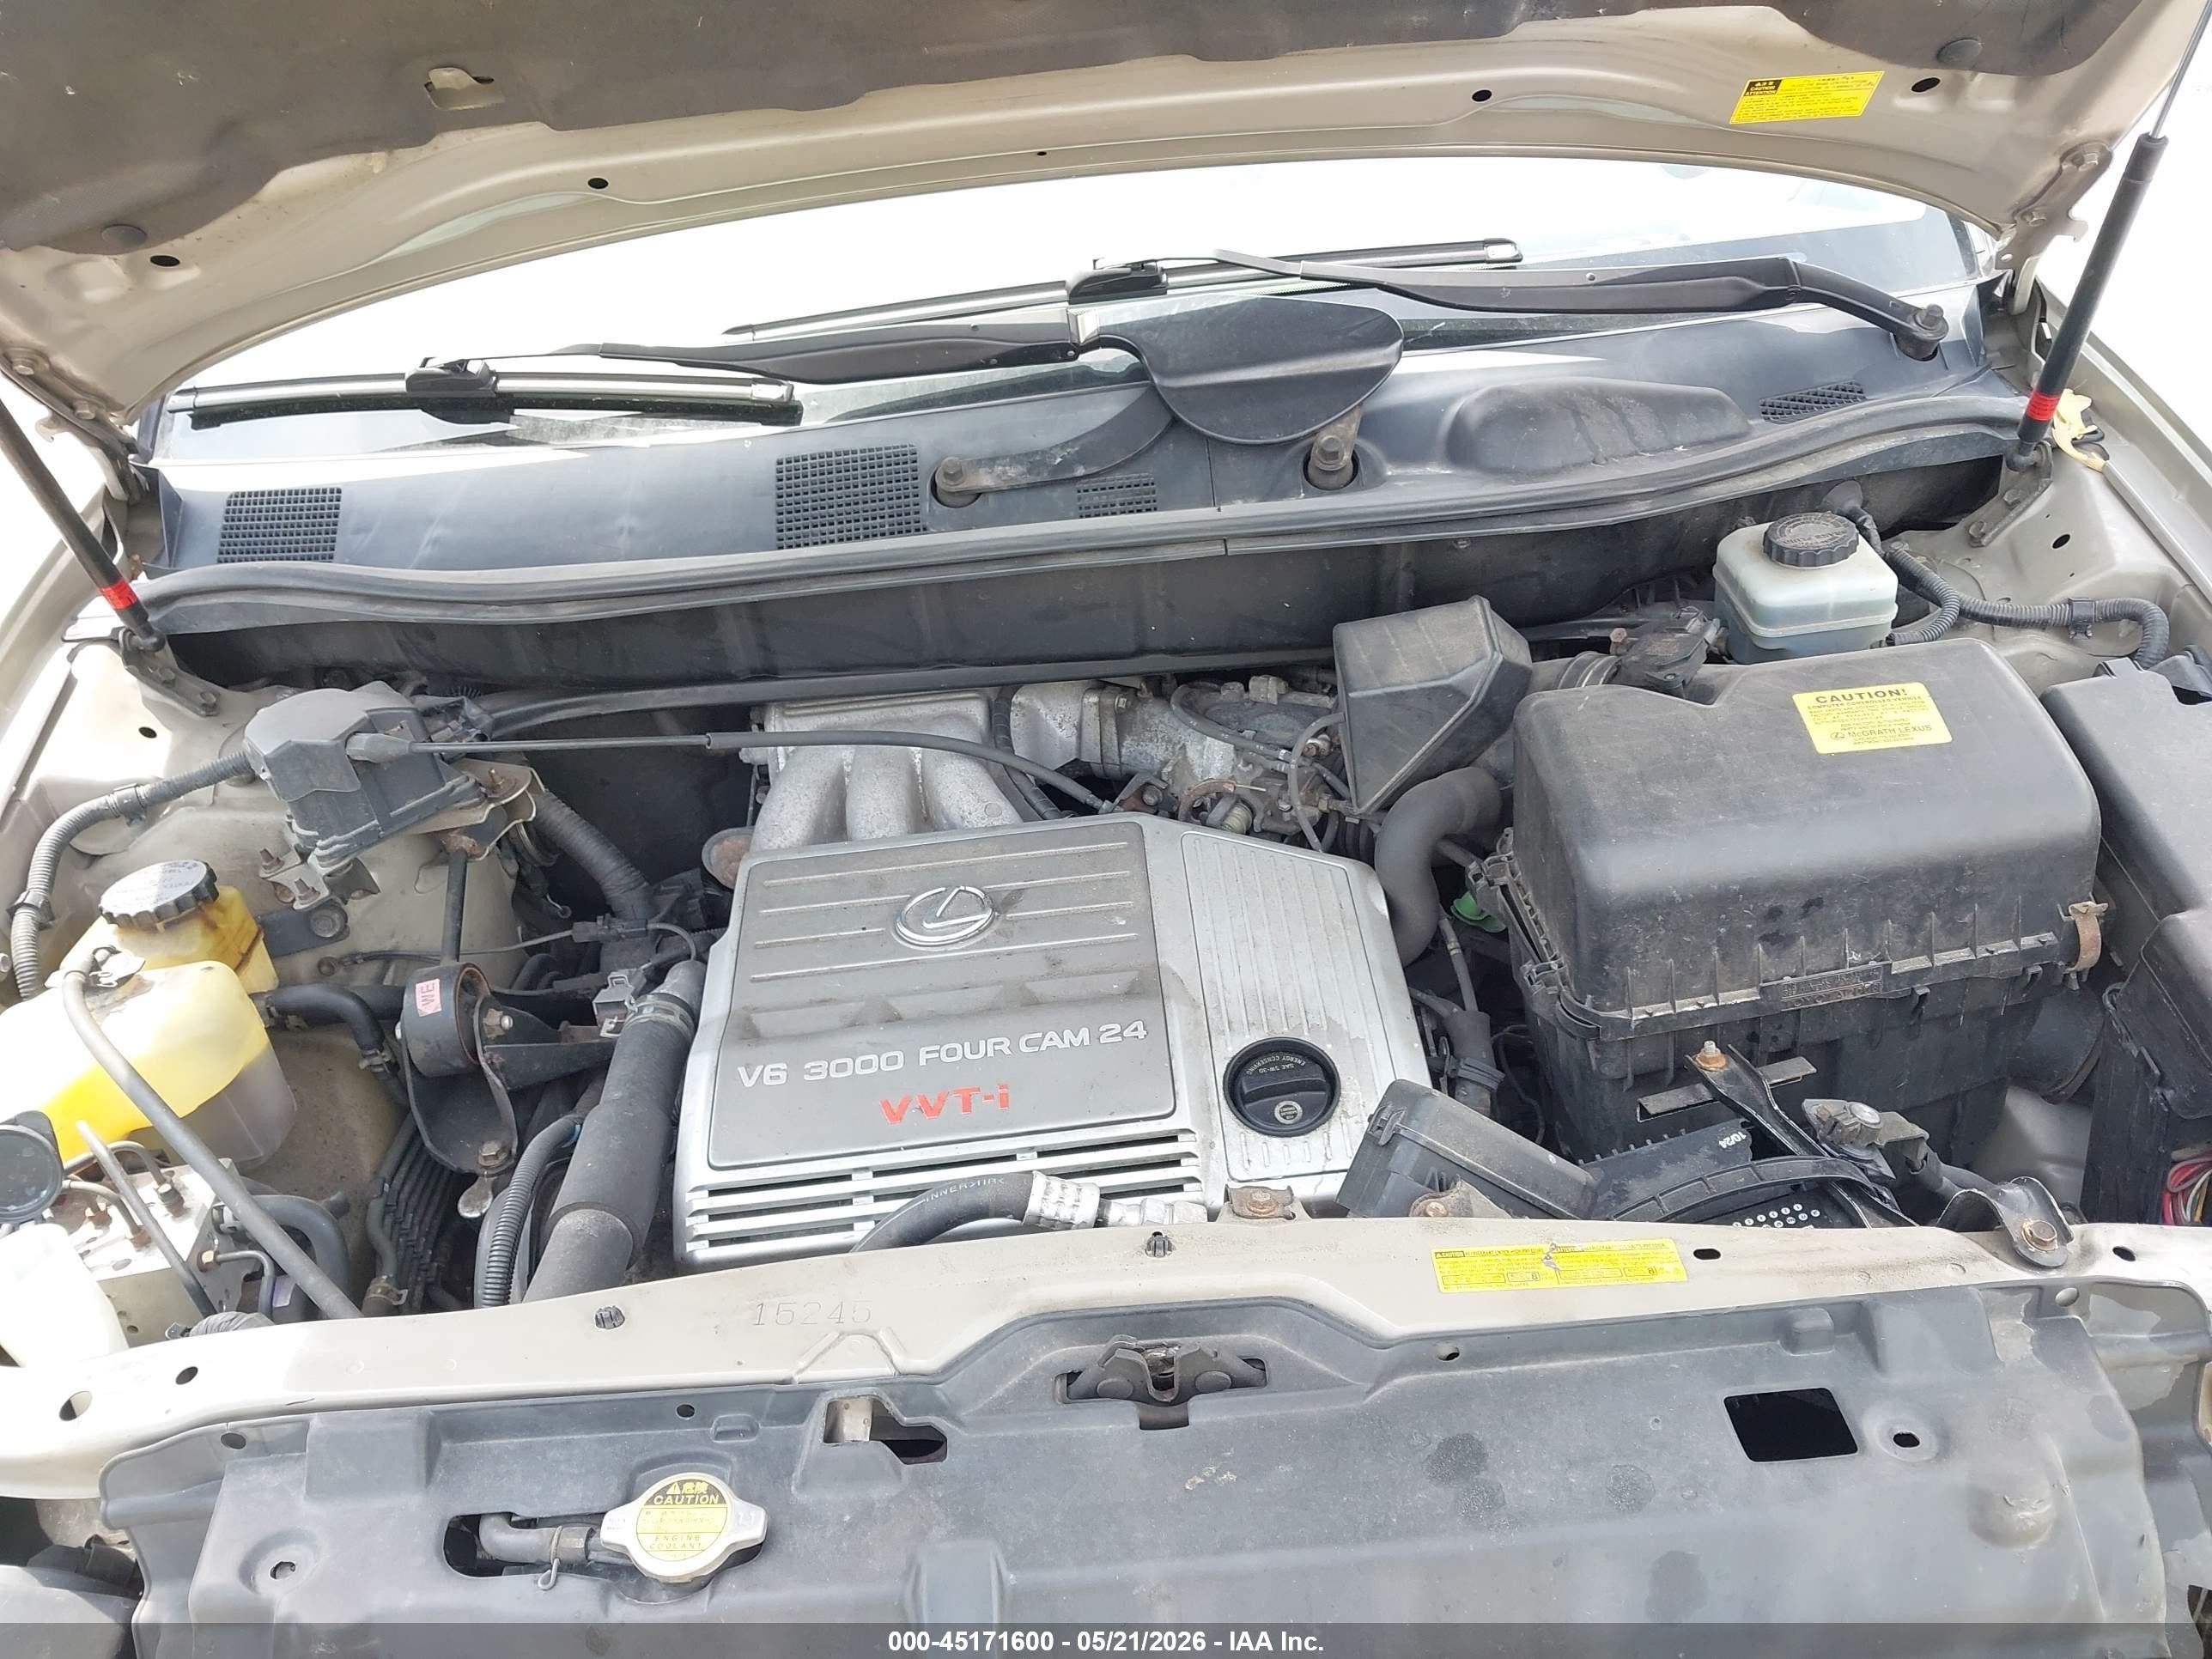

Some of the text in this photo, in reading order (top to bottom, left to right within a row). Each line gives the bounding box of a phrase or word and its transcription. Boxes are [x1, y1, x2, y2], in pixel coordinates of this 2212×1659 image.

[1815, 689, 1908, 704] CAUTION!
[1848, 725, 1933, 738] McGRATH LEXUS
[738, 1020, 1148, 1088] V6 3000 FOUR CAM 24
[1281, 1054, 1306, 1066] ENERGY
[879, 1084, 1011, 1126] VVT-i
[752, 1300, 872, 1326] 15245
[653, 1494, 719, 1505] CAUTION
